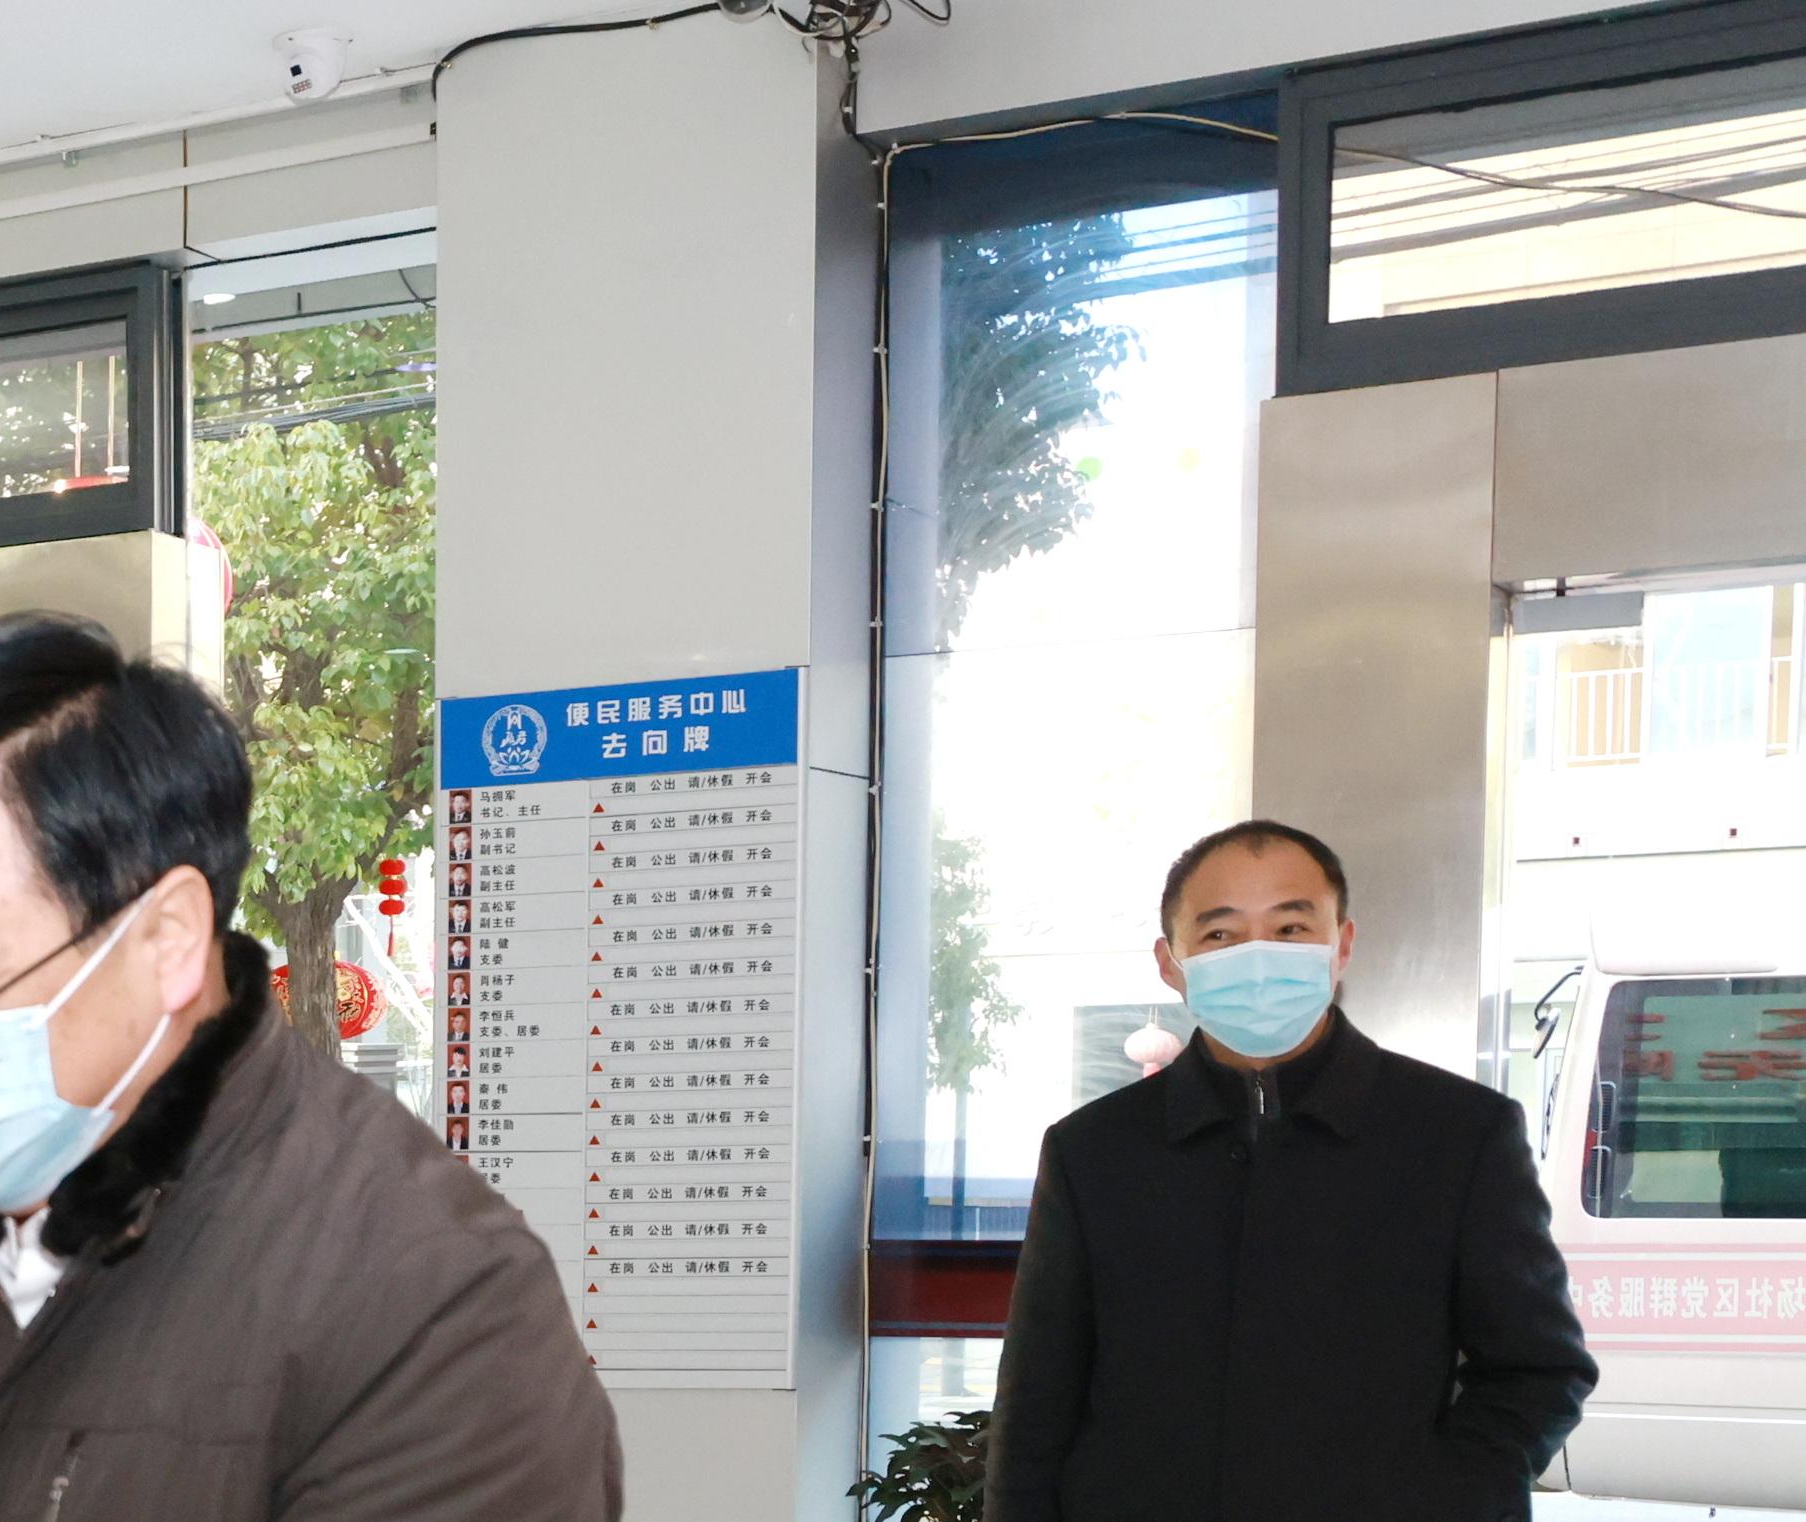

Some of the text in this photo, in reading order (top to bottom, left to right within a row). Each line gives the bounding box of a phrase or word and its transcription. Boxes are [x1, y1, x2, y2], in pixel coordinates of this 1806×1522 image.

[566, 688, 747, 727] 便民服务中心
[602, 726, 710, 759] 去向牌
[611, 771, 771, 794] 在岗 公出 请/休假 开会
[611, 809, 772, 832] 在岗 公出 请/休假 开会
[479, 843, 517, 856] 副书记
[612, 847, 772, 868] 在岗 公出 请/休假 开会
[480, 880, 516, 892] 副主任
[613, 885, 772, 905] 在岗 公出 请/休假 开会
[479, 916, 516, 929] 副主任
[613, 922, 772, 943] 在岗 公出 请/休假 开会
[480, 953, 503, 966] 支委
[613, 960, 772, 979] 在岗 公出 请/休假 开会
[478, 990, 503, 1002] 支委
[610, 999, 770, 1016] 在岗 公出 请/休假 开会
[478, 1024, 541, 1038] 支委、居委
[610, 1036, 770, 1052] 在岗 公出 请/休假 开会
[479, 1062, 502, 1074] 居委
[610, 1073, 769, 1089] 在岗 公出 请/休假 开会
[478, 1099, 502, 1111] 居委
[611, 1110, 769, 1126] 在岗 公出 请/休假 开会
[478, 1134, 501, 1146] 居委
[478, 1157, 514, 1168] 王汉宁
[611, 1147, 770, 1163] 在岗 公出 请/休假 开会
[609, 1185, 767, 1200] 在岗 公出 请/休假 开会
[609, 1223, 767, 1237] 在岗 公出 请/休假 开会
[609, 1261, 768, 1274] 在岗 公出 请/休假 开会
